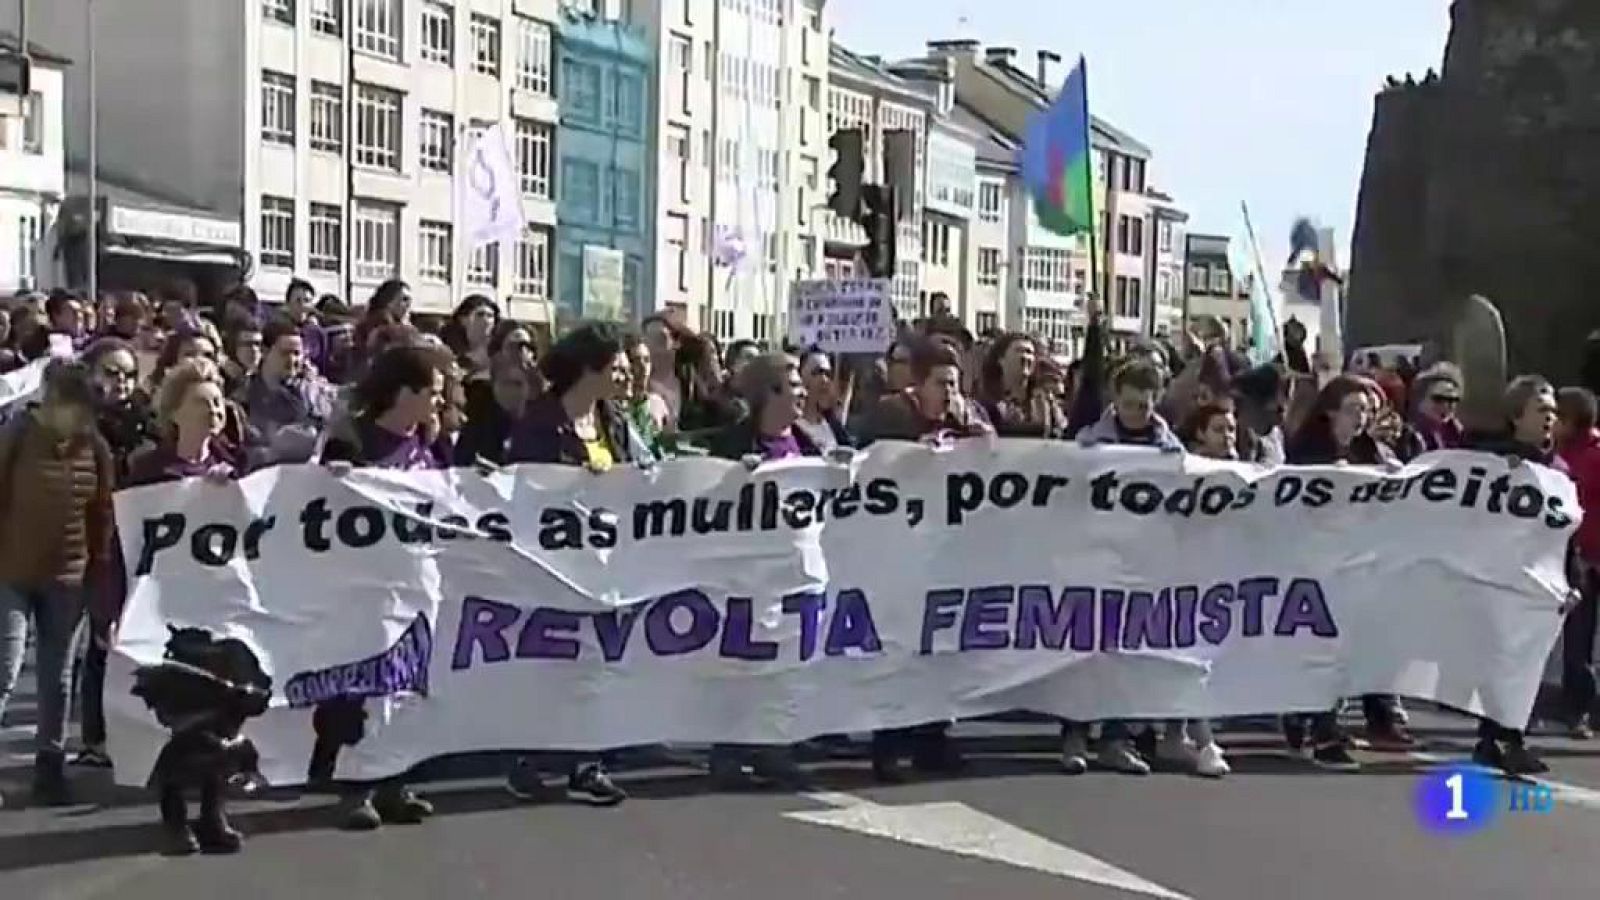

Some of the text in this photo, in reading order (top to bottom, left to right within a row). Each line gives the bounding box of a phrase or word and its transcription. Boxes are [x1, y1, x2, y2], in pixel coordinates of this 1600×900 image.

[135, 511, 276, 577] Por
[539, 505, 618, 550] as
[946, 471, 1069, 526] por
[1090, 469, 1257, 519] todos
[1273, 474, 1336, 508] os
[451, 587, 882, 671] REVOLTA
[918, 577, 1339, 656] FEMINISTA
